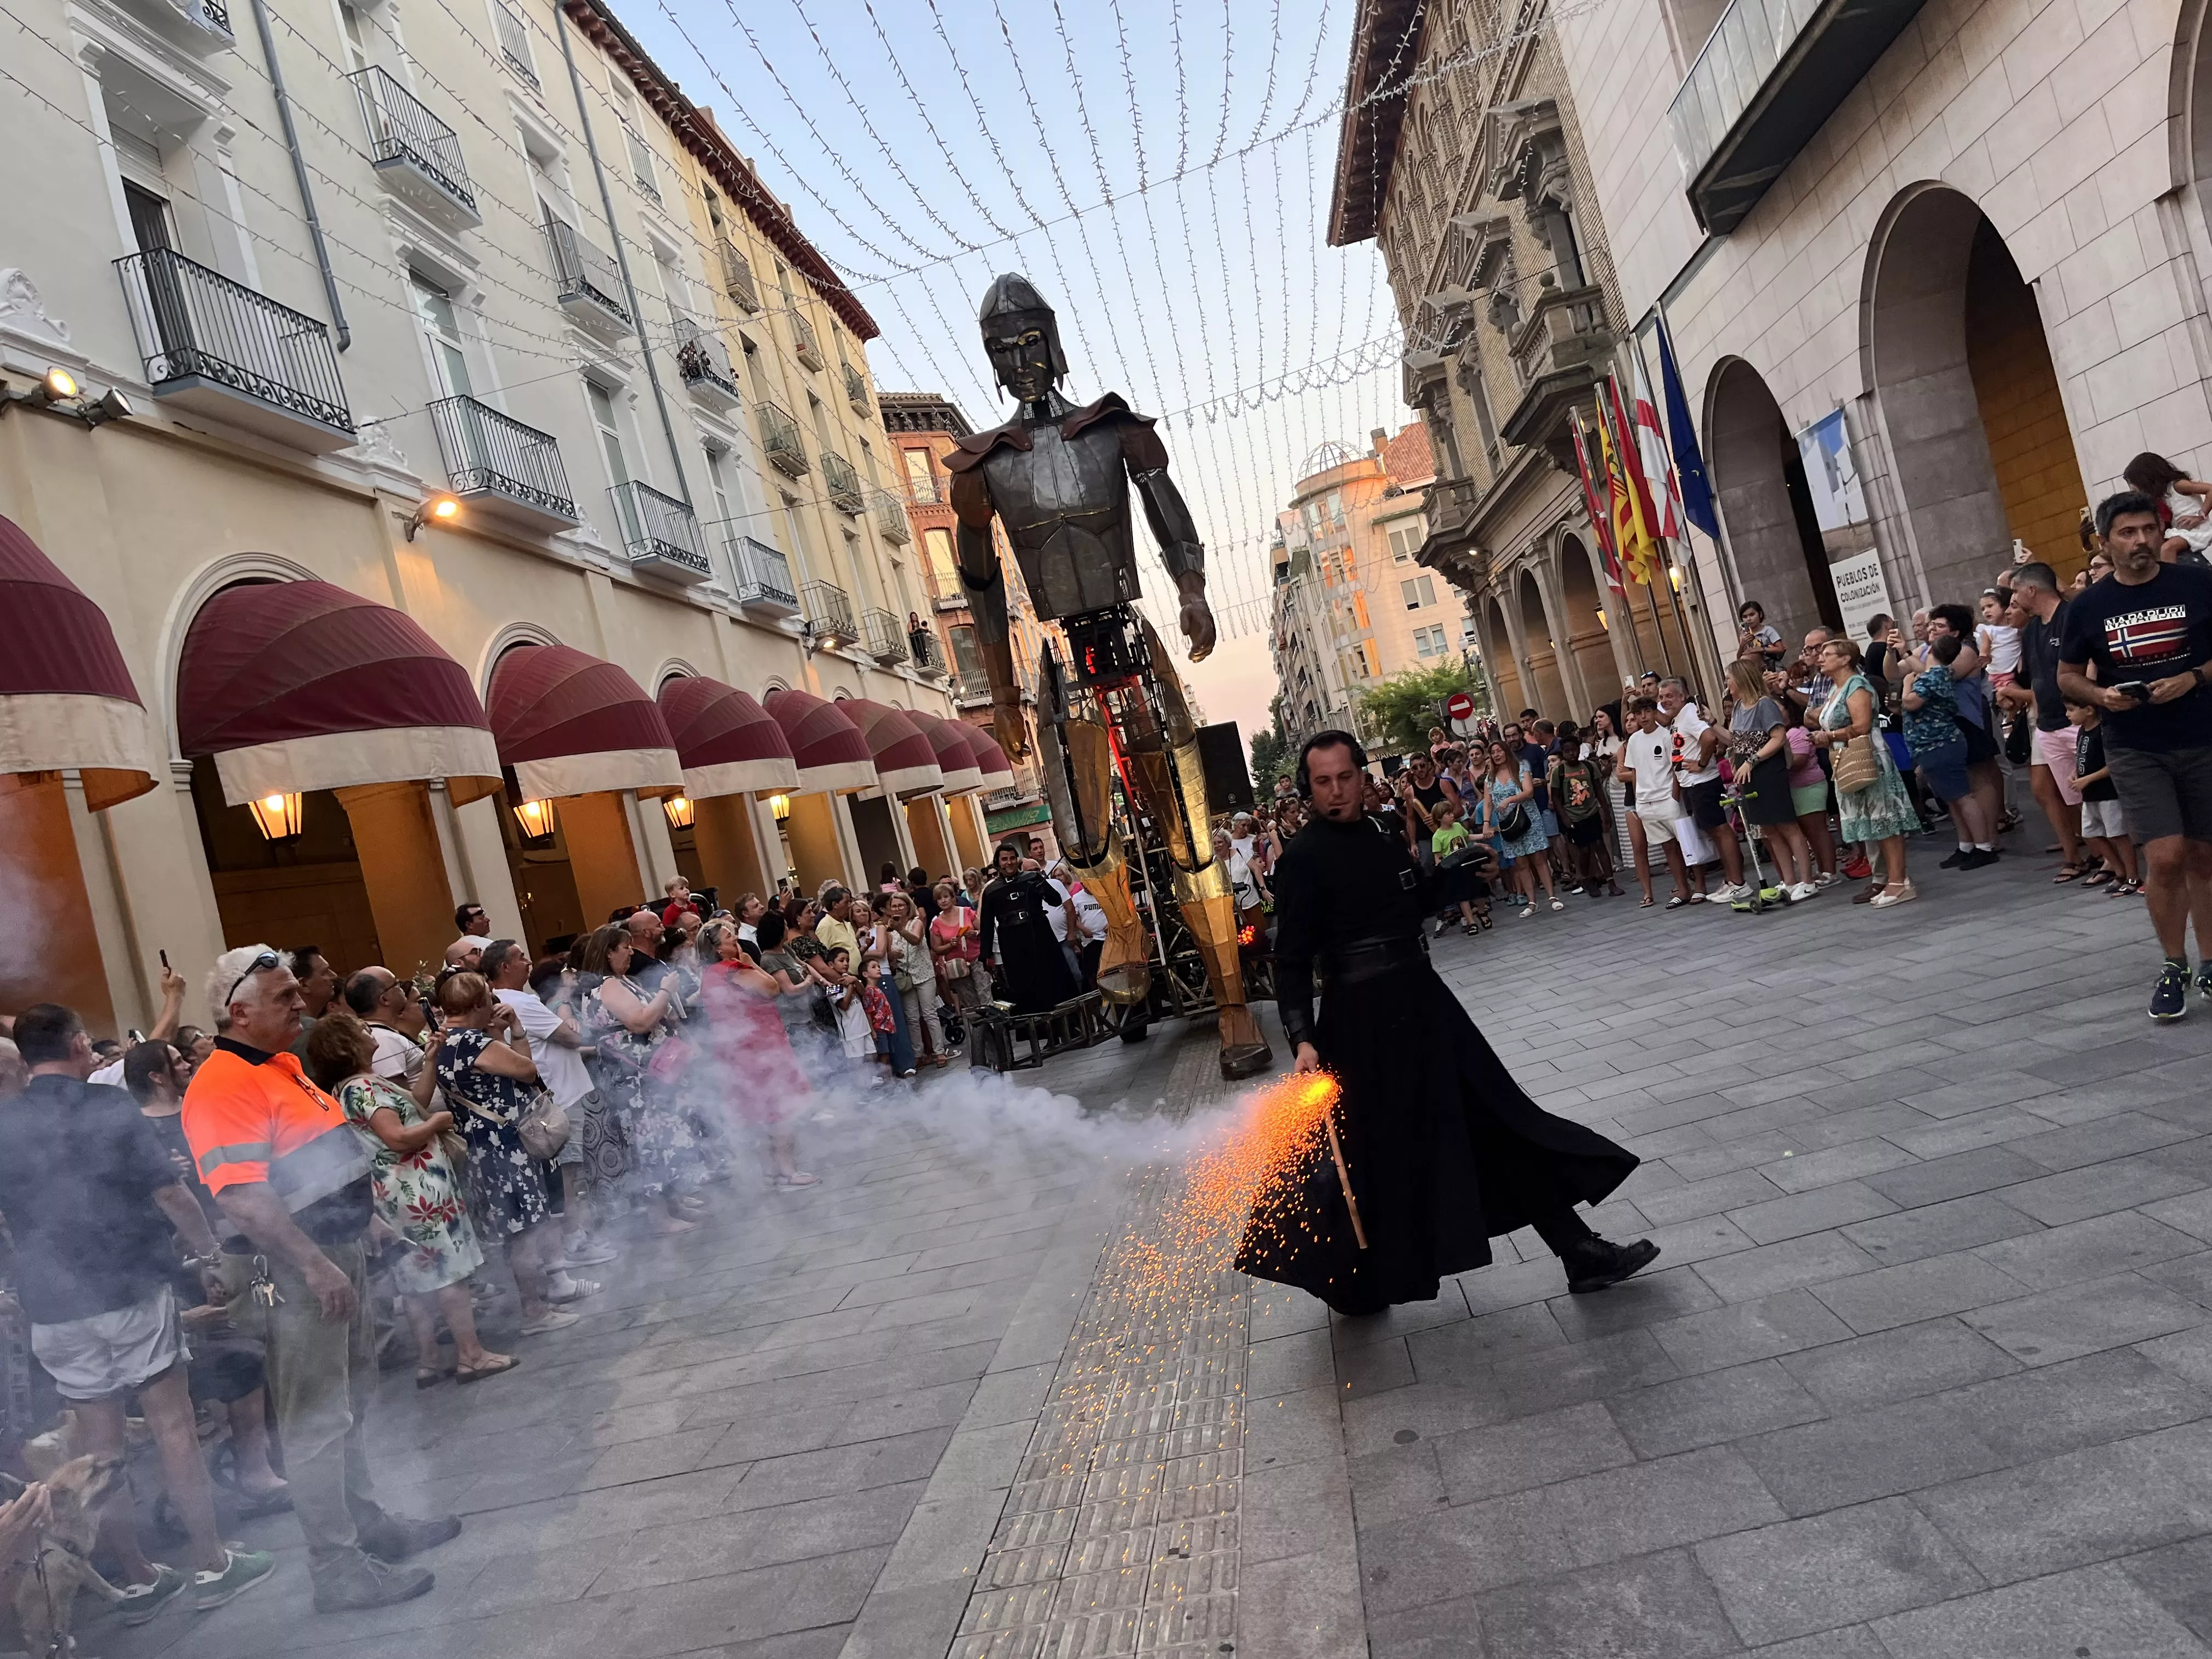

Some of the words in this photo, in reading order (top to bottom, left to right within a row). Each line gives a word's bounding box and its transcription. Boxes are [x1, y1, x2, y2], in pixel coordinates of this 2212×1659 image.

[1836, 567, 1868, 588] PUEBLOS
[1868, 563, 1878, 578] DE
[1840, 582, 1881, 602] COLONIZACIÓN
[2106, 606, 2185, 630] NAPAPIJRI
[1374, 747, 1406, 761] MANGO
